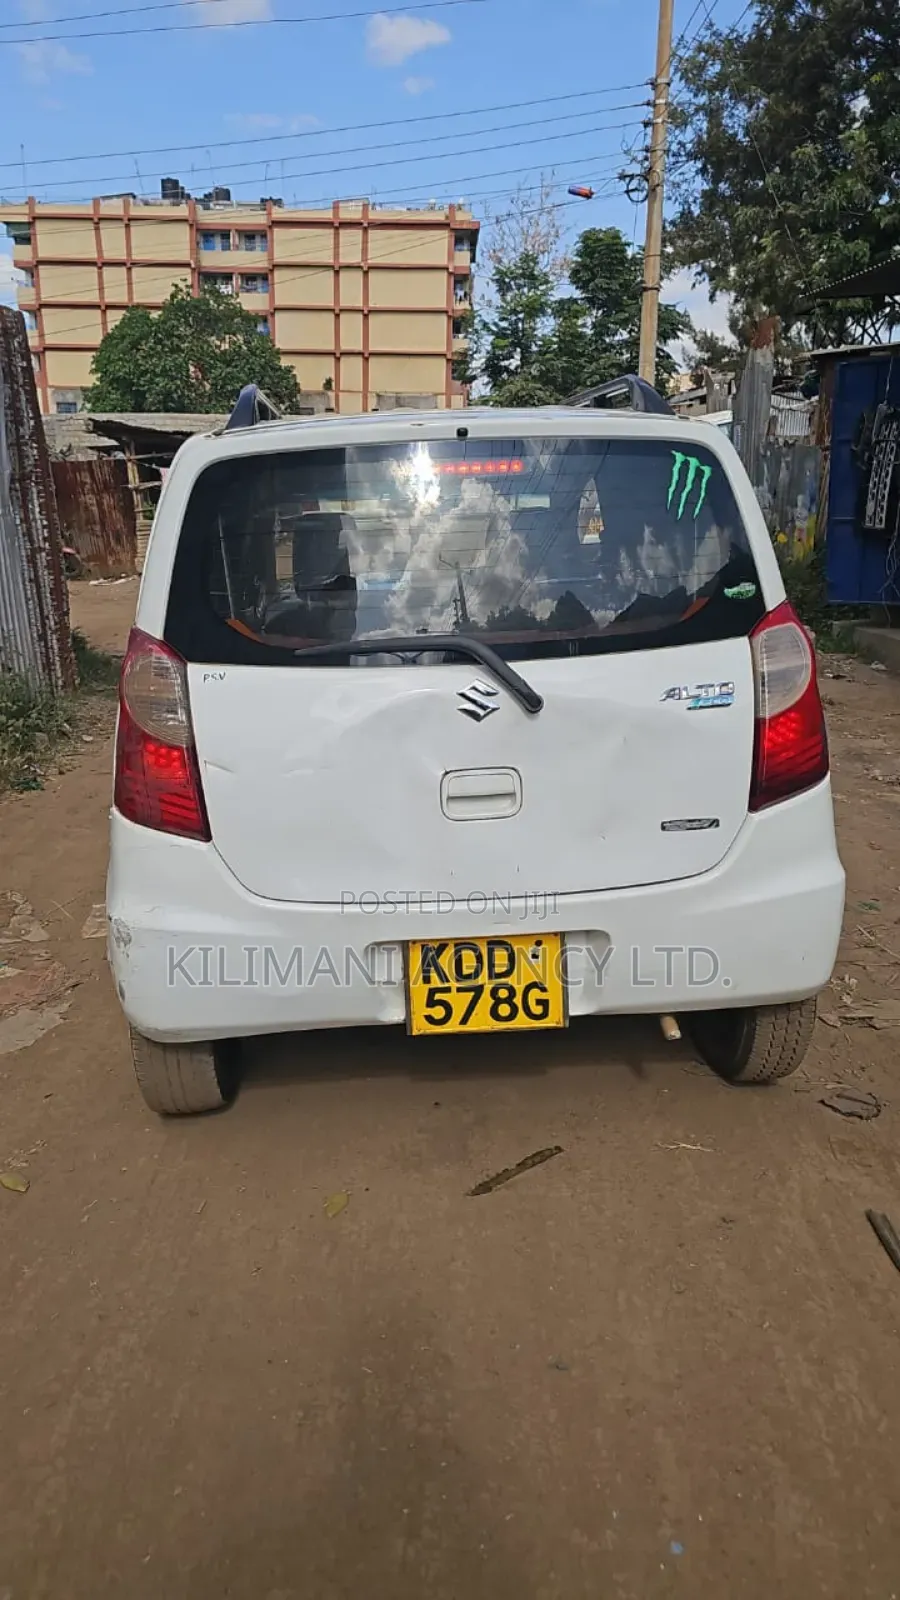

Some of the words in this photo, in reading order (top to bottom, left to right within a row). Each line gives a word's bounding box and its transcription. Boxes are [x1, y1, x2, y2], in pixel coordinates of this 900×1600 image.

[659, 681, 735, 701] ALTO
[420, 939, 516, 985] KDD
[423, 981, 551, 1026] 578G
